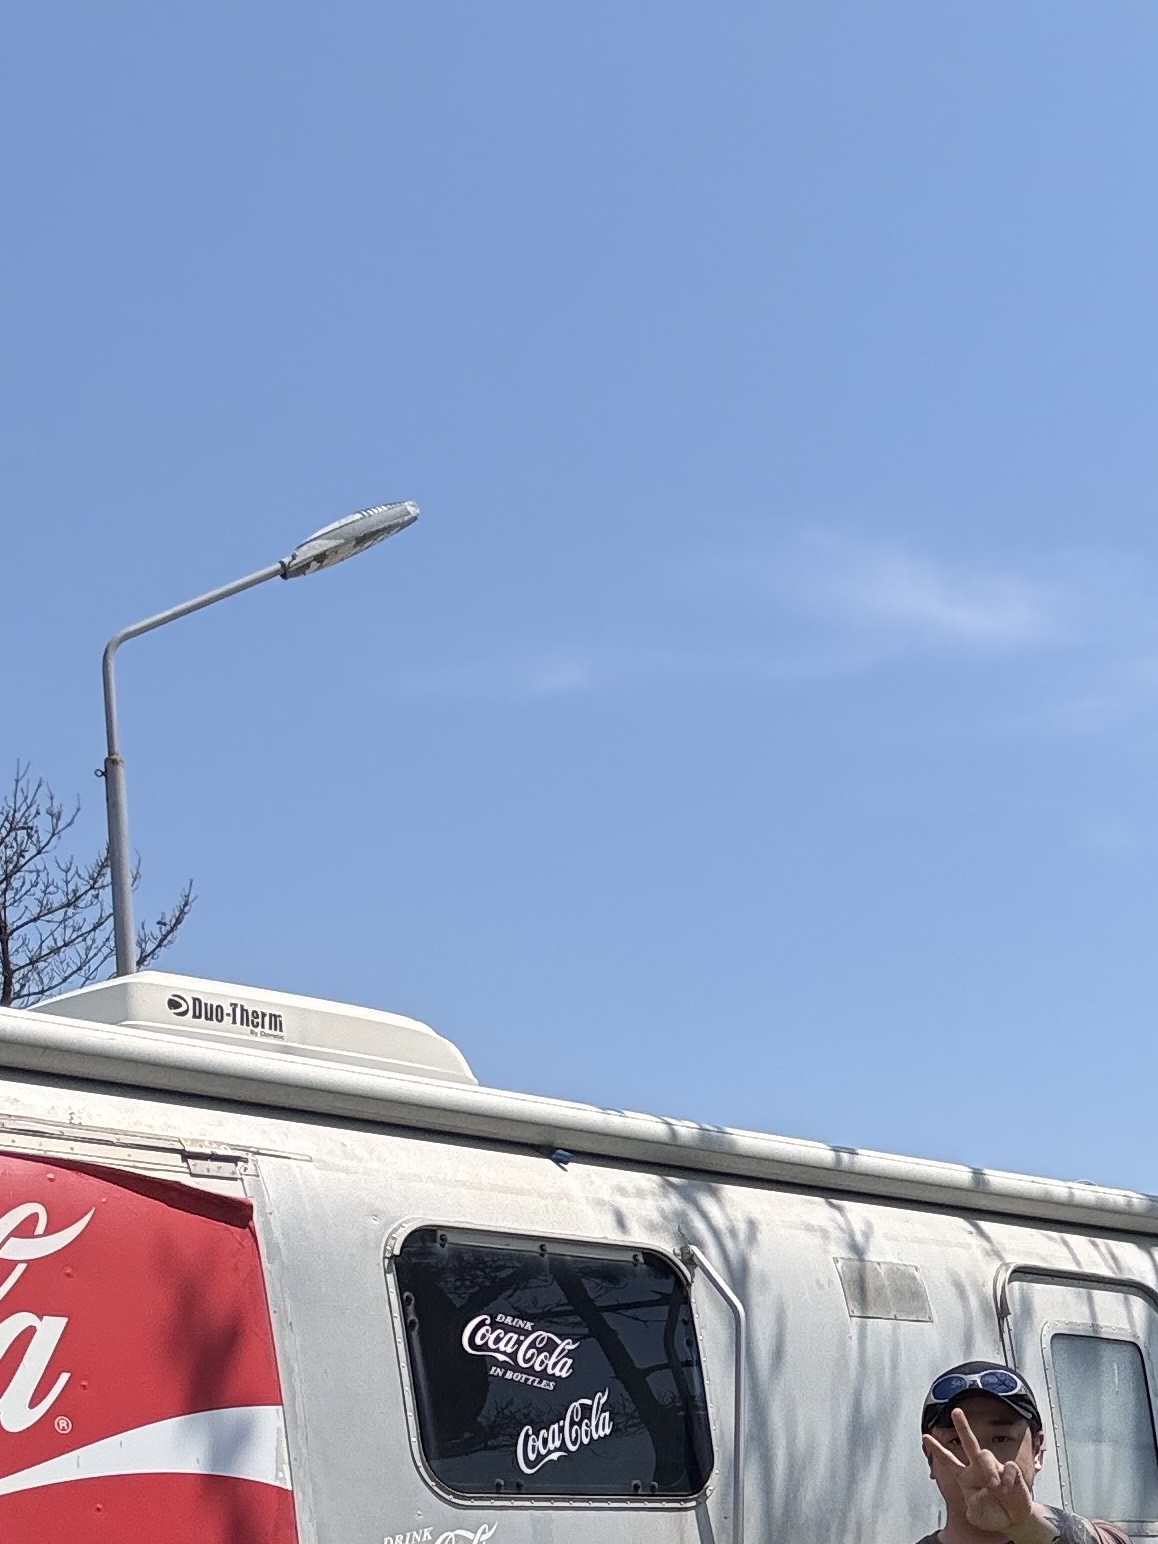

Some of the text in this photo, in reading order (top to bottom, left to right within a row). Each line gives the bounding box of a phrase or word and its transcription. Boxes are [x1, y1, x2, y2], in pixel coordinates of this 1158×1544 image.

[191, 996, 284, 1032] Duo-Therm
[496, 1313, 535, 1331] DRINK
[461, 1314, 580, 1378] Coca-Cola
[489, 1366, 556, 1391] IN BOTTLES
[516, 1387, 614, 1475] Coca-Cola
